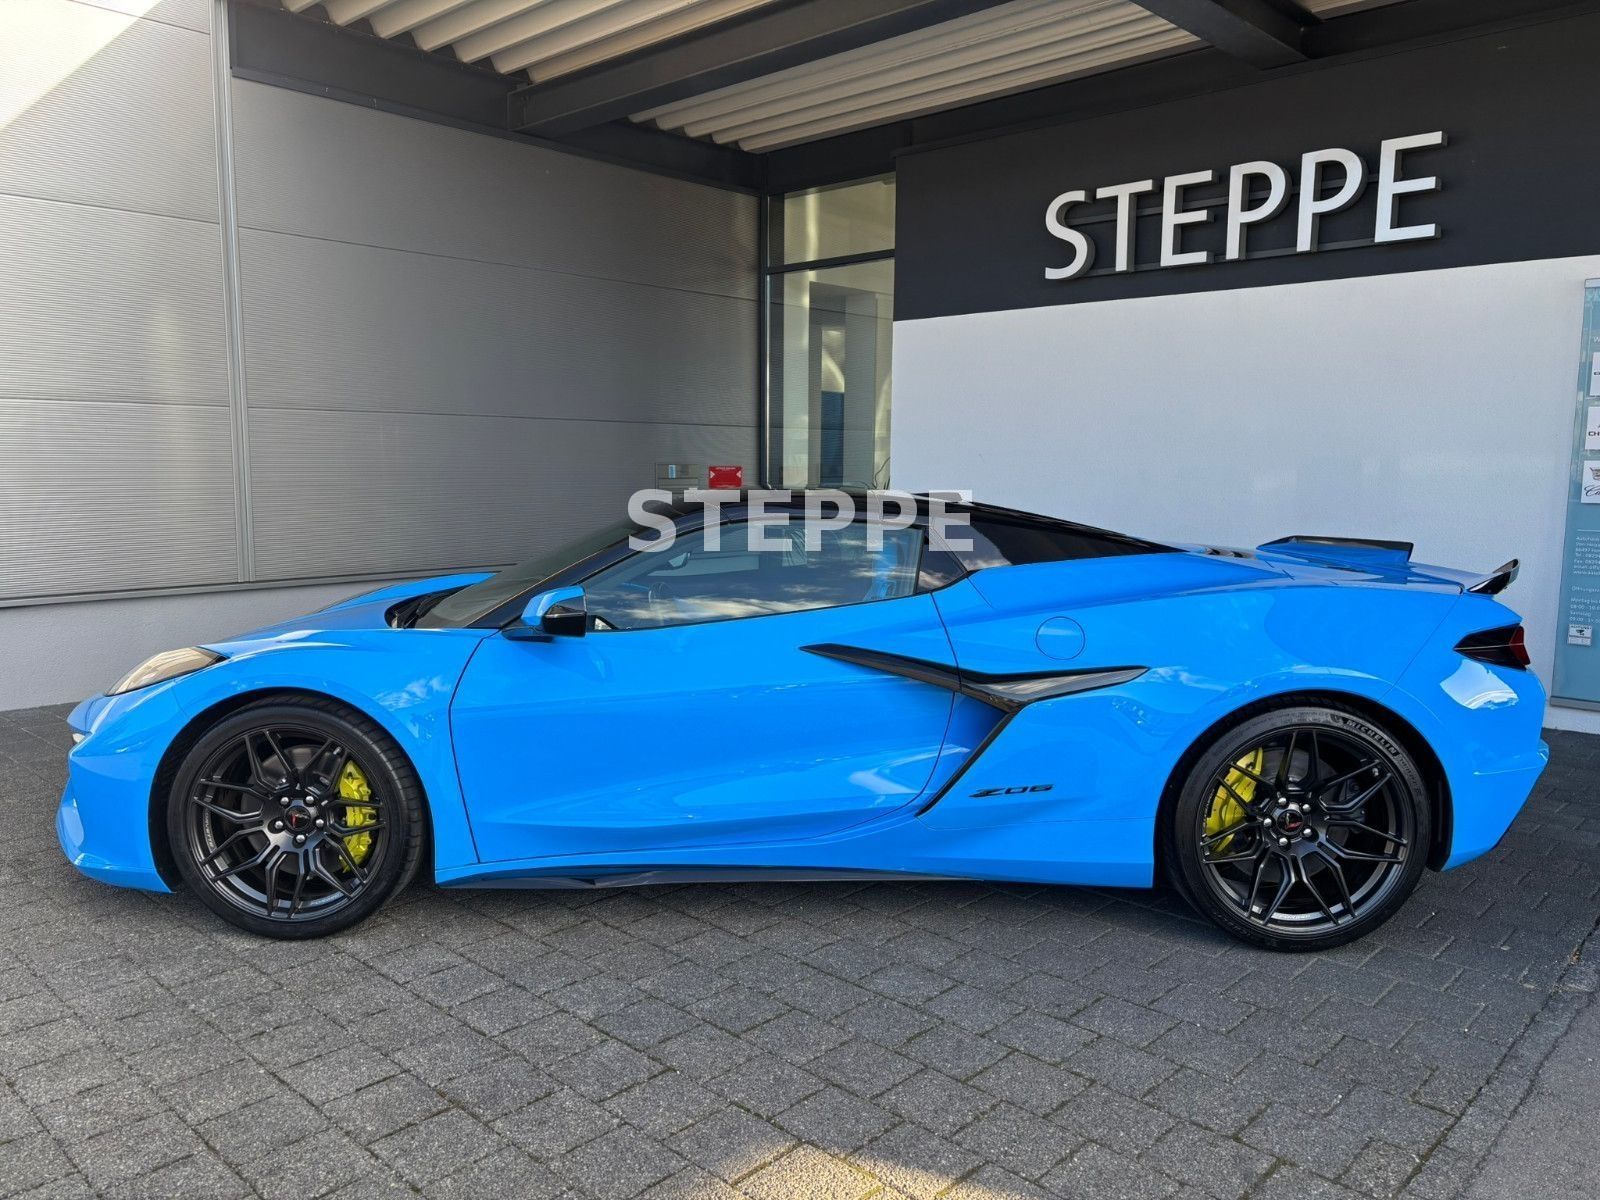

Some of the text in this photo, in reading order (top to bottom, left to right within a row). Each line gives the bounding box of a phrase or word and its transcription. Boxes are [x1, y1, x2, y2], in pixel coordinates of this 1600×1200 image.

[1044, 131, 1446, 280] STEPPE
[1345, 718, 1400, 757] MICHELIN
[968, 784, 1054, 798] Z06
